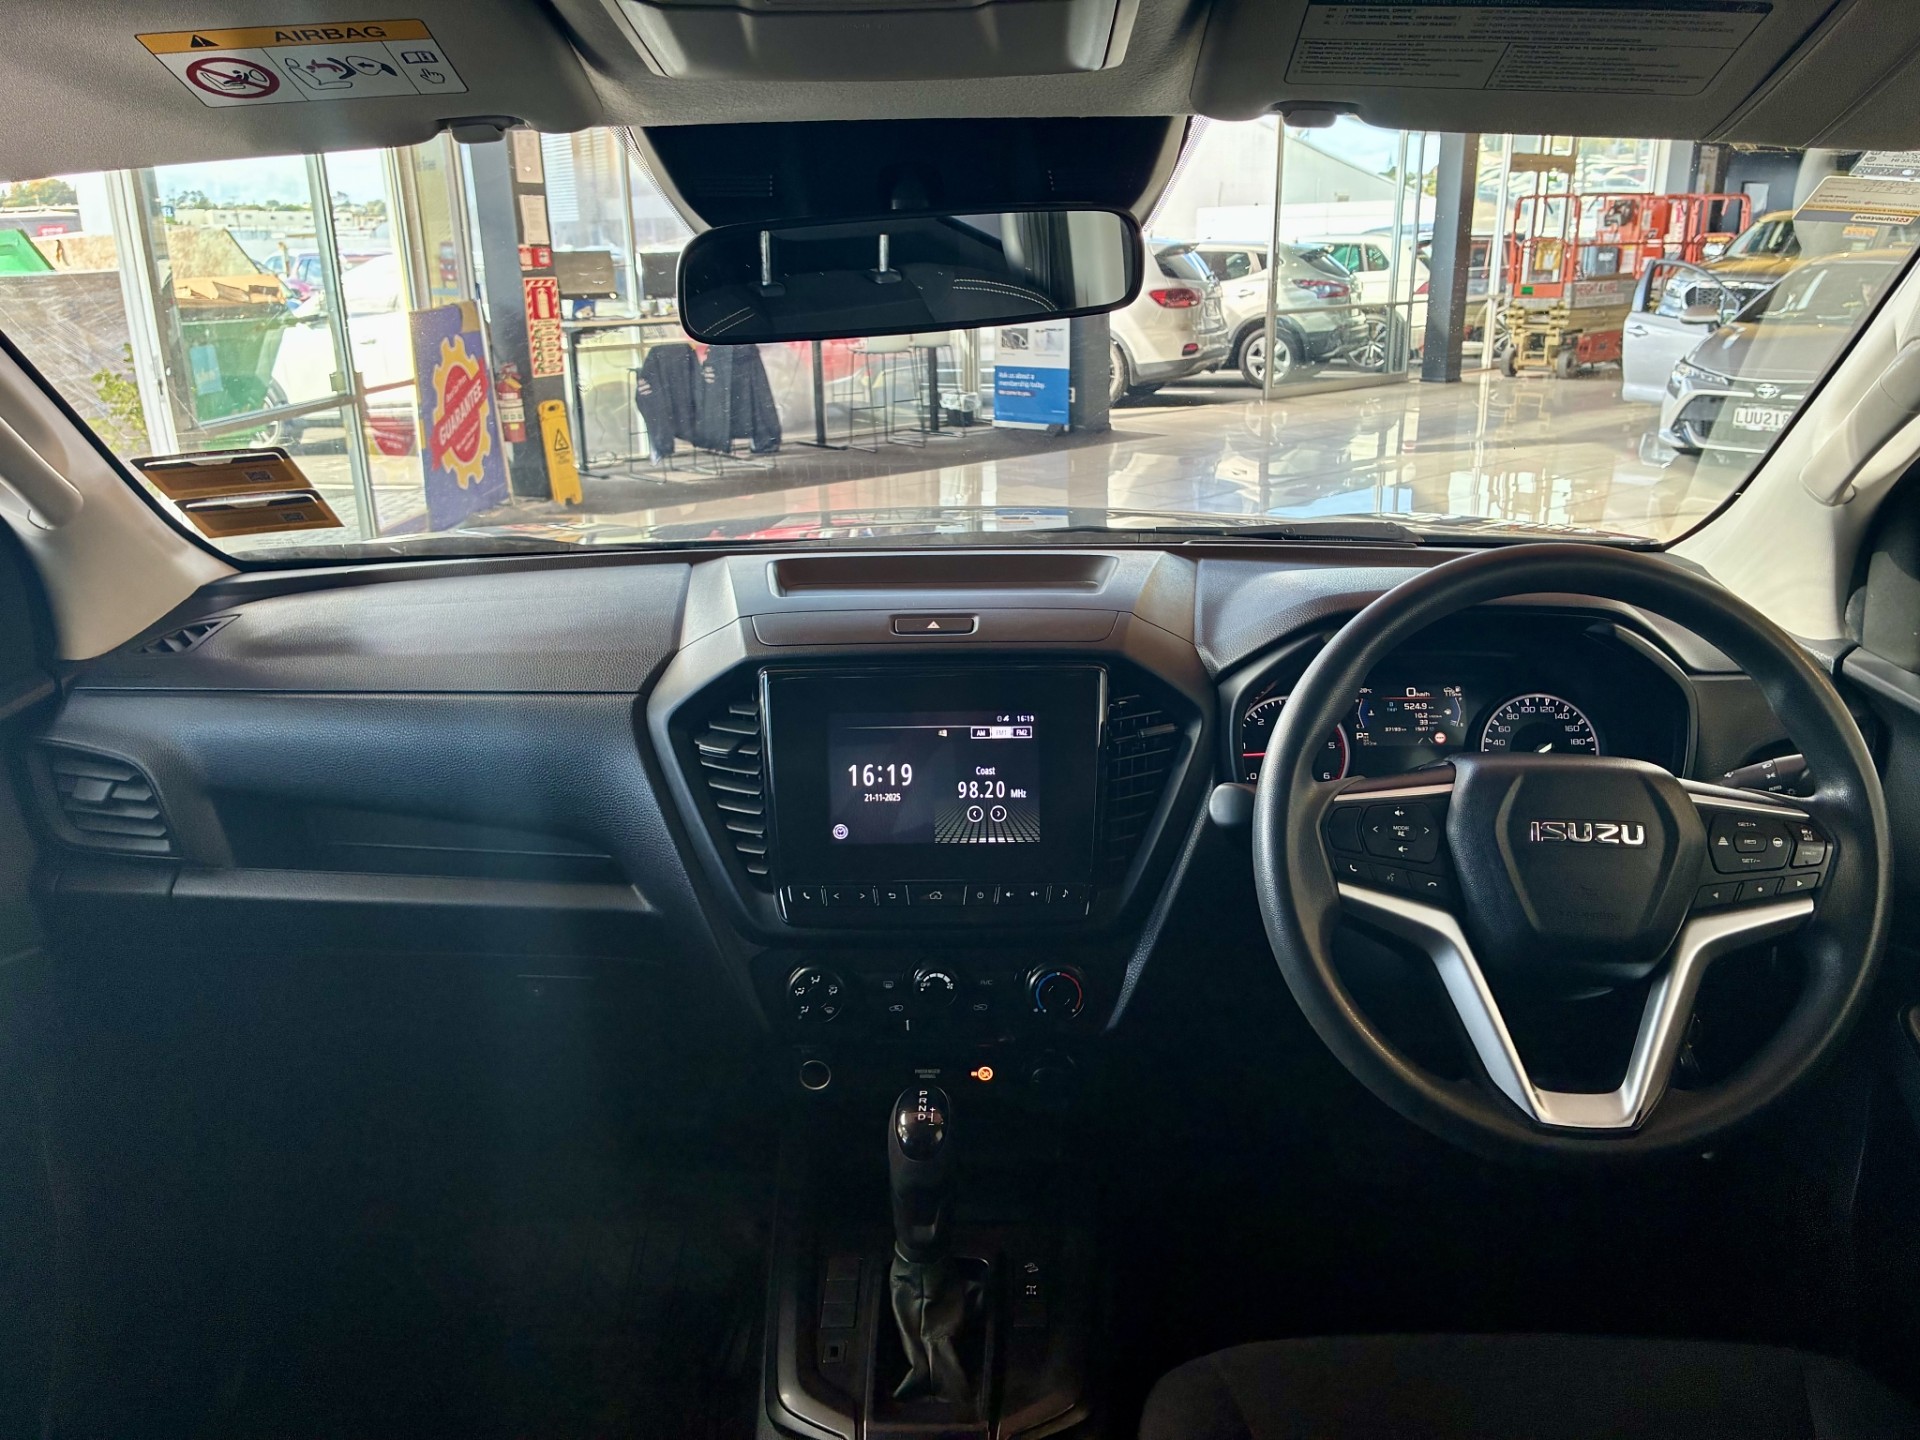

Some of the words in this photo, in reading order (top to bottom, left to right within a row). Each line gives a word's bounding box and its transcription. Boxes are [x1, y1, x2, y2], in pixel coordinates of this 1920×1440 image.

[275, 26, 387, 42] AIRBAG
[440, 378, 483, 446] GUARANTEE
[1403, 702, 1428, 710] 524.9
[976, 729, 986, 737] AM
[1016, 728, 1028, 736] FM2
[1356, 732, 1364, 740] P
[1570, 738, 1586, 746] 180
[848, 763, 913, 787] 16:19
[975, 766, 996, 776] Coast
[957, 780, 1005, 799] 98.20
[1010, 788, 1027, 799] MHz
[864, 793, 901, 802] 21-11-2025
[1530, 821, 1645, 845] ISUZU
